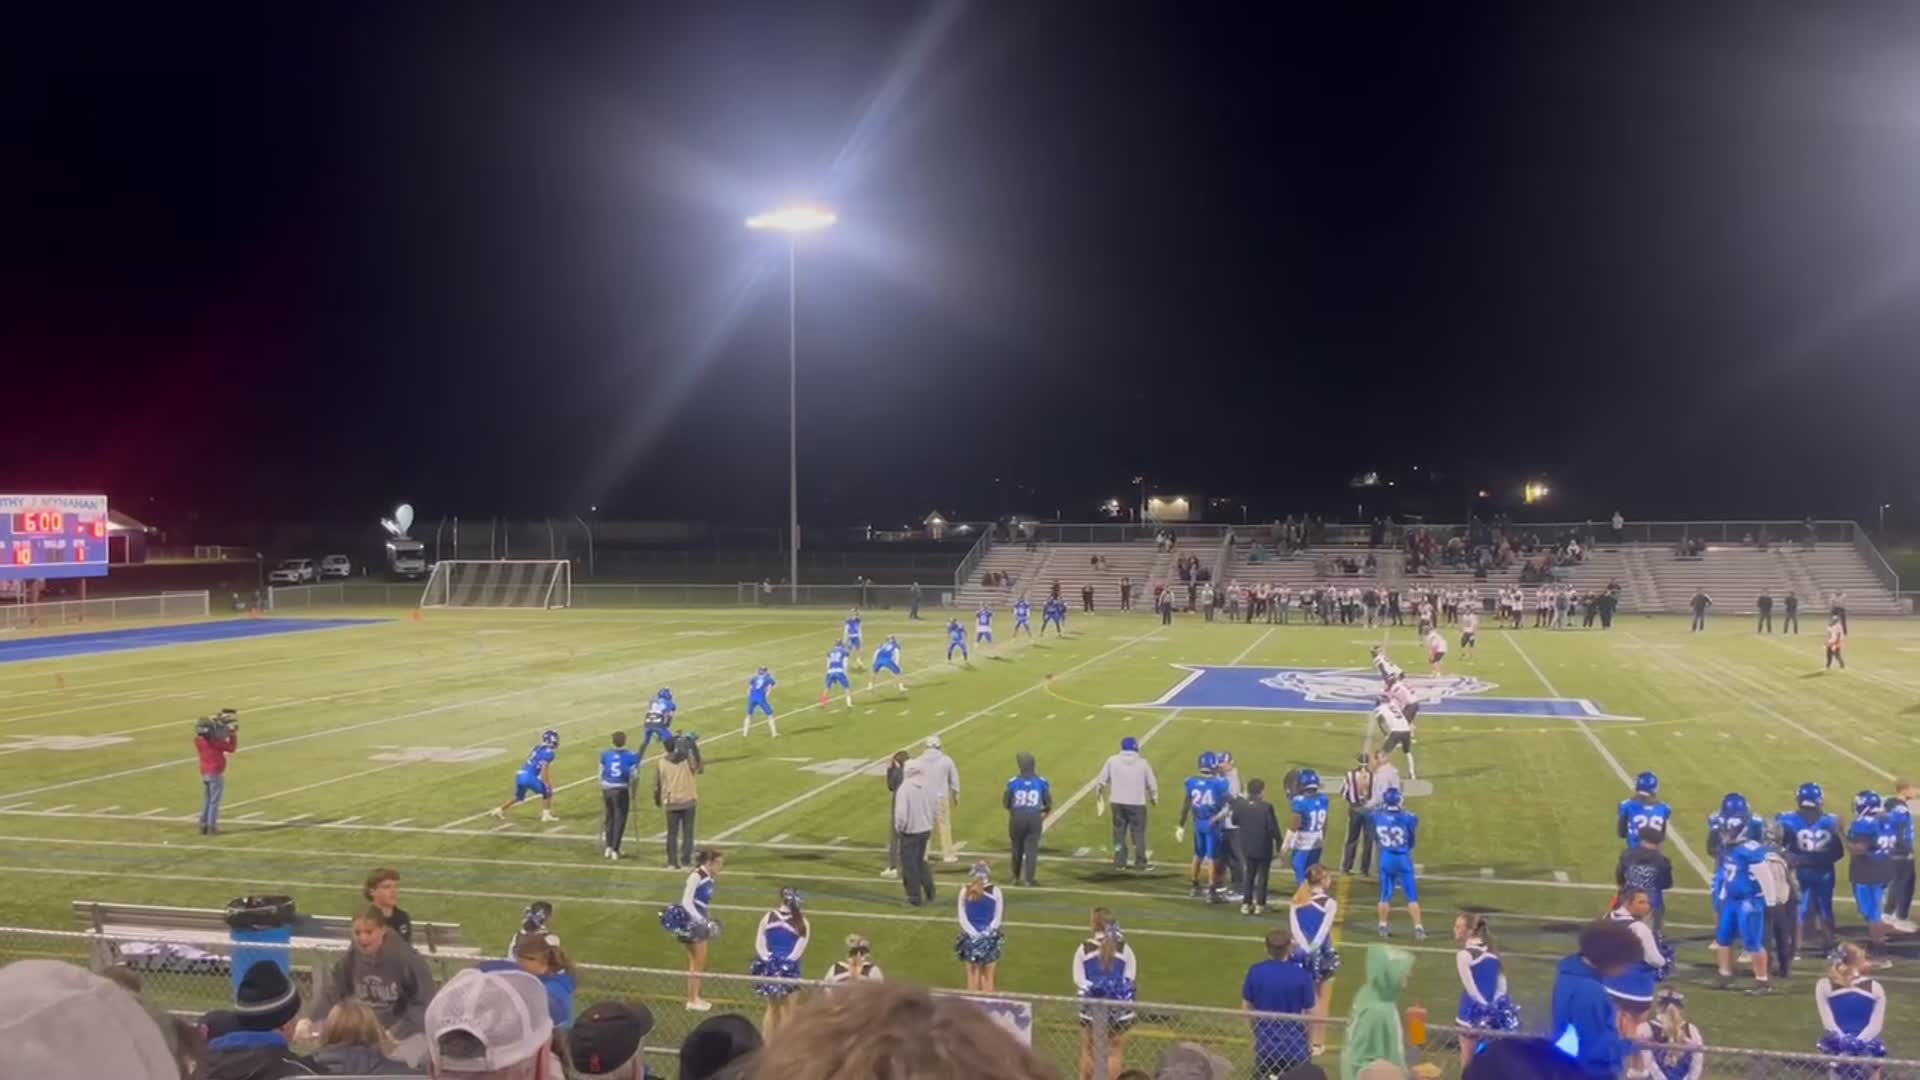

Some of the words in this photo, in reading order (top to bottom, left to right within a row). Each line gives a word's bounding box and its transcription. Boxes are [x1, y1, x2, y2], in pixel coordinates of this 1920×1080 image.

[610, 762, 621, 777] 5
[1191, 788, 1216, 808] 24
[1309, 809, 1327, 832] 19
[1376, 825, 1406, 848] 53
